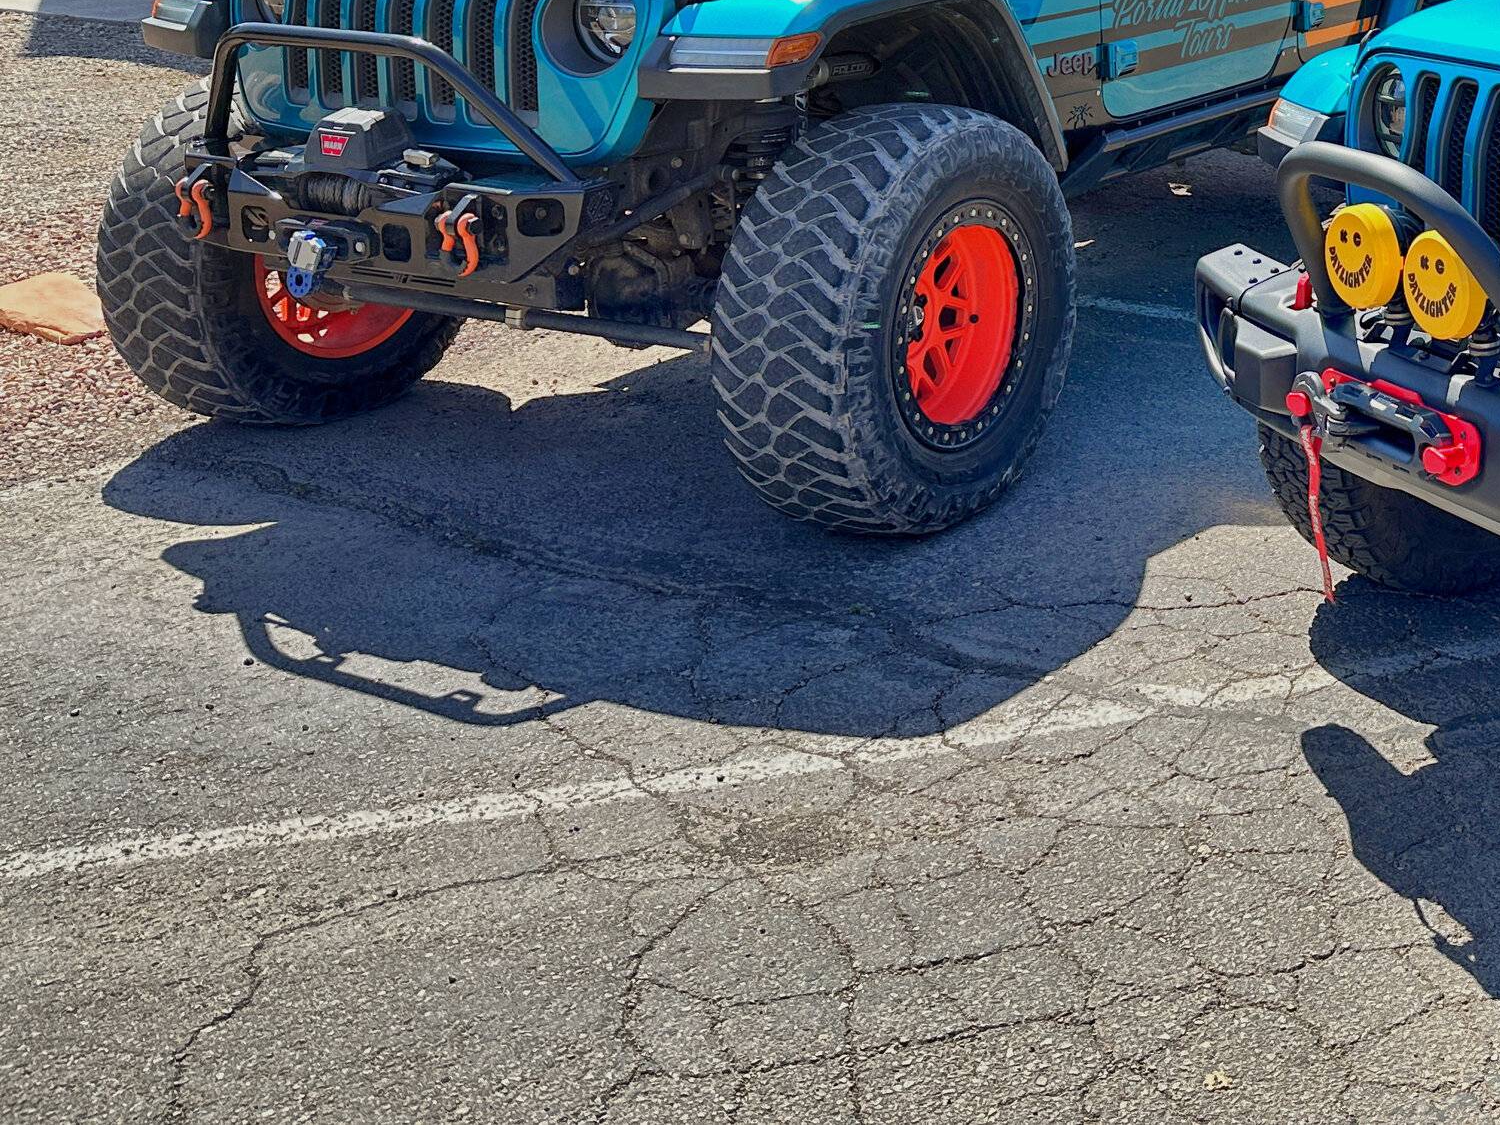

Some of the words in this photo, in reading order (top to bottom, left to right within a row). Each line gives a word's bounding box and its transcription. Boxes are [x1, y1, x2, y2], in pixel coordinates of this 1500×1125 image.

[1174, 18, 1233, 58] Tours
[1047, 52, 1096, 77] Jeep
[1329, 246, 1373, 288] DAYLIGHTER
[1408, 272, 1457, 318] DAYLIGHTER
